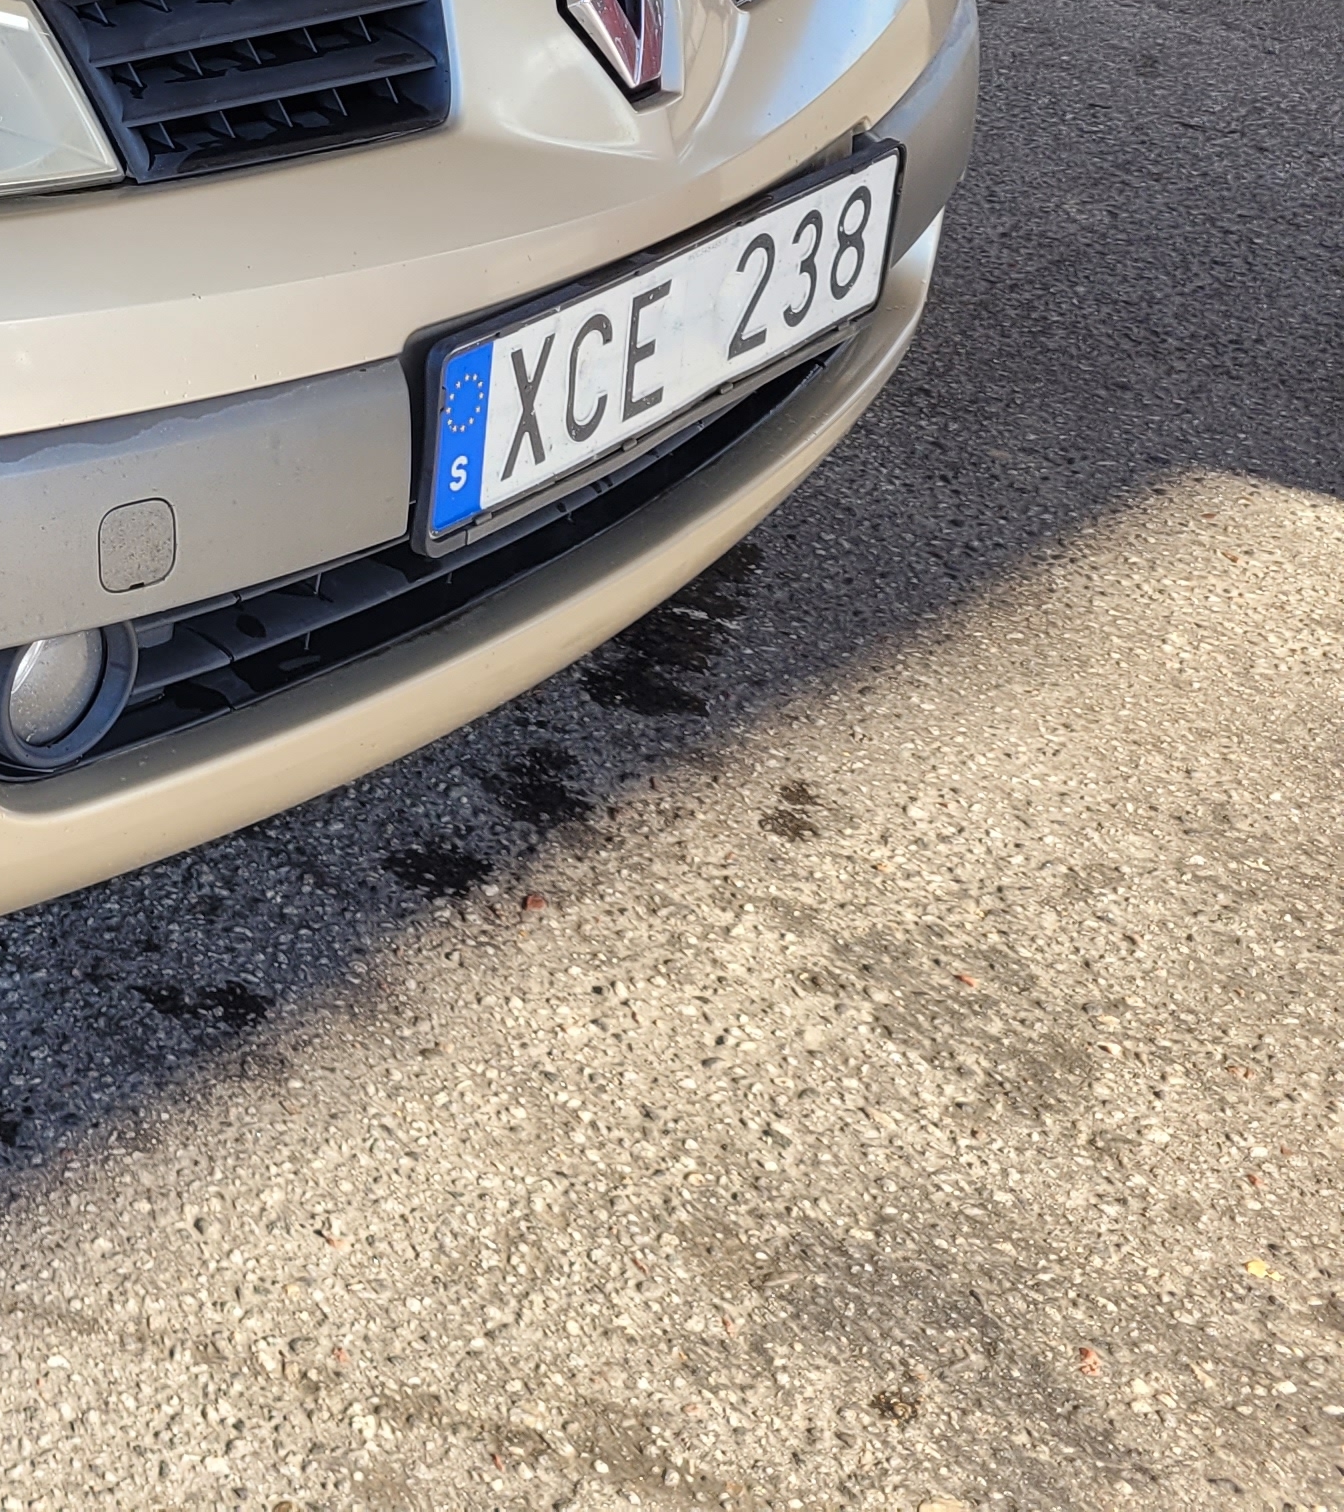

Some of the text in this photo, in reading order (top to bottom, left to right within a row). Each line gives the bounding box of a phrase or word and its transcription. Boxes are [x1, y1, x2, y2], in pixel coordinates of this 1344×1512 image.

[500, 186, 872, 483] XCE 238
[449, 455, 468, 492] S
